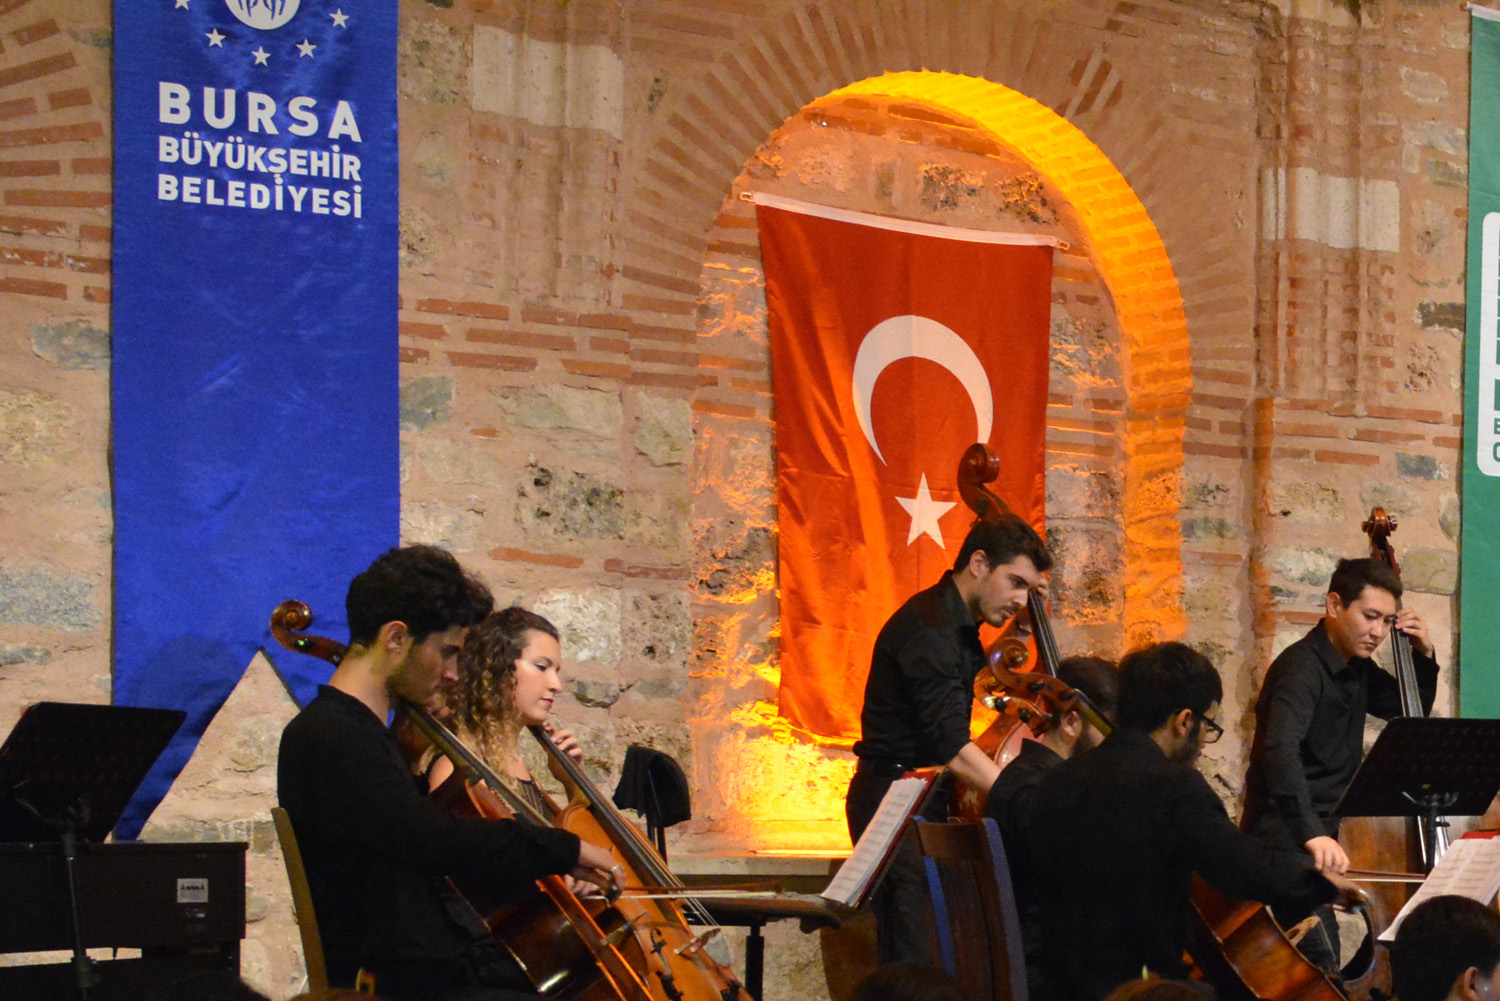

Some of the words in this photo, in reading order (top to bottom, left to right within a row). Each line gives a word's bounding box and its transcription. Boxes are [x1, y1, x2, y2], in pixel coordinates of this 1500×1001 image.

[159, 81, 362, 143] BURSA
[159, 131, 362, 182] BÜYÜKŞEHİR
[158, 173, 362, 219] BELEDİYESİ
